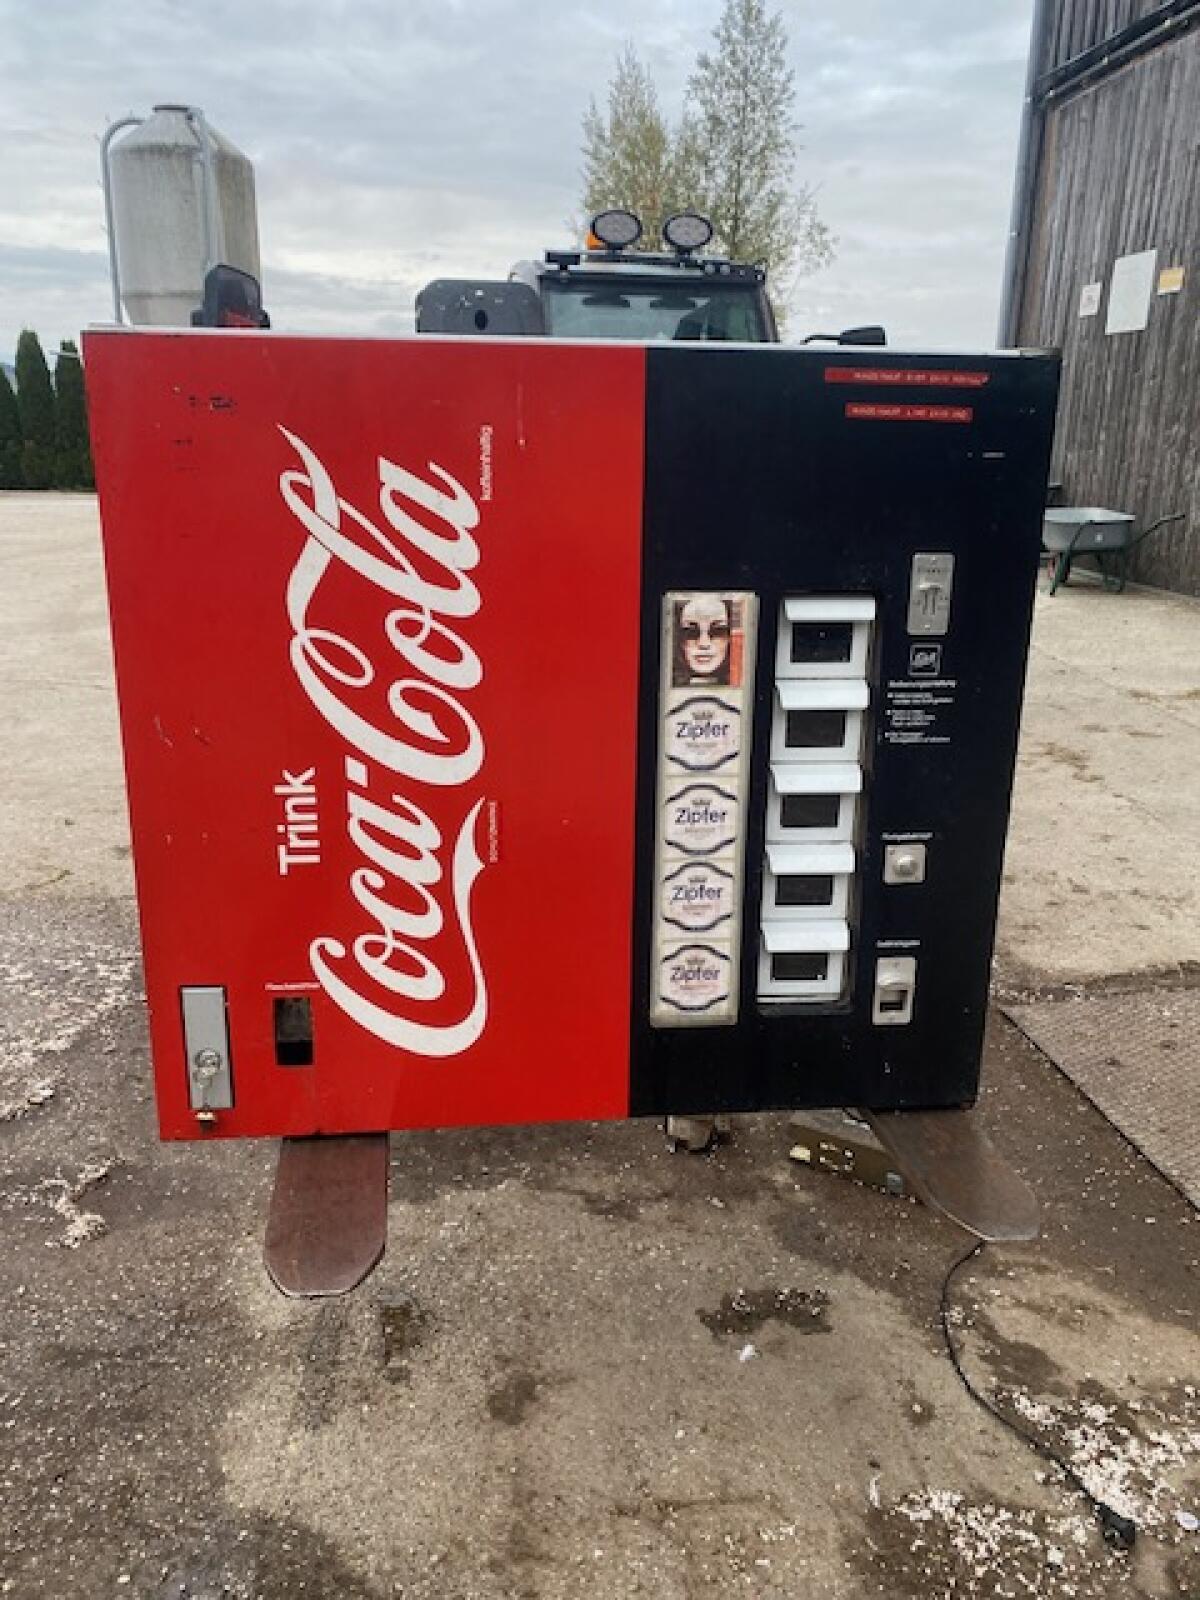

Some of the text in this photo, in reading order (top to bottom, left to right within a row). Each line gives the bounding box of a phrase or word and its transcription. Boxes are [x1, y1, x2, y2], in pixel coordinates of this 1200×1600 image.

[277, 424, 488, 1056] Coca-Cola
[675, 721, 730, 740] Zipfer
[273, 767, 320, 876] Trink
[674, 807, 728, 826] Zipfer
[671, 884, 723, 903] Zipfer
[670, 965, 721, 984] Zipfer
